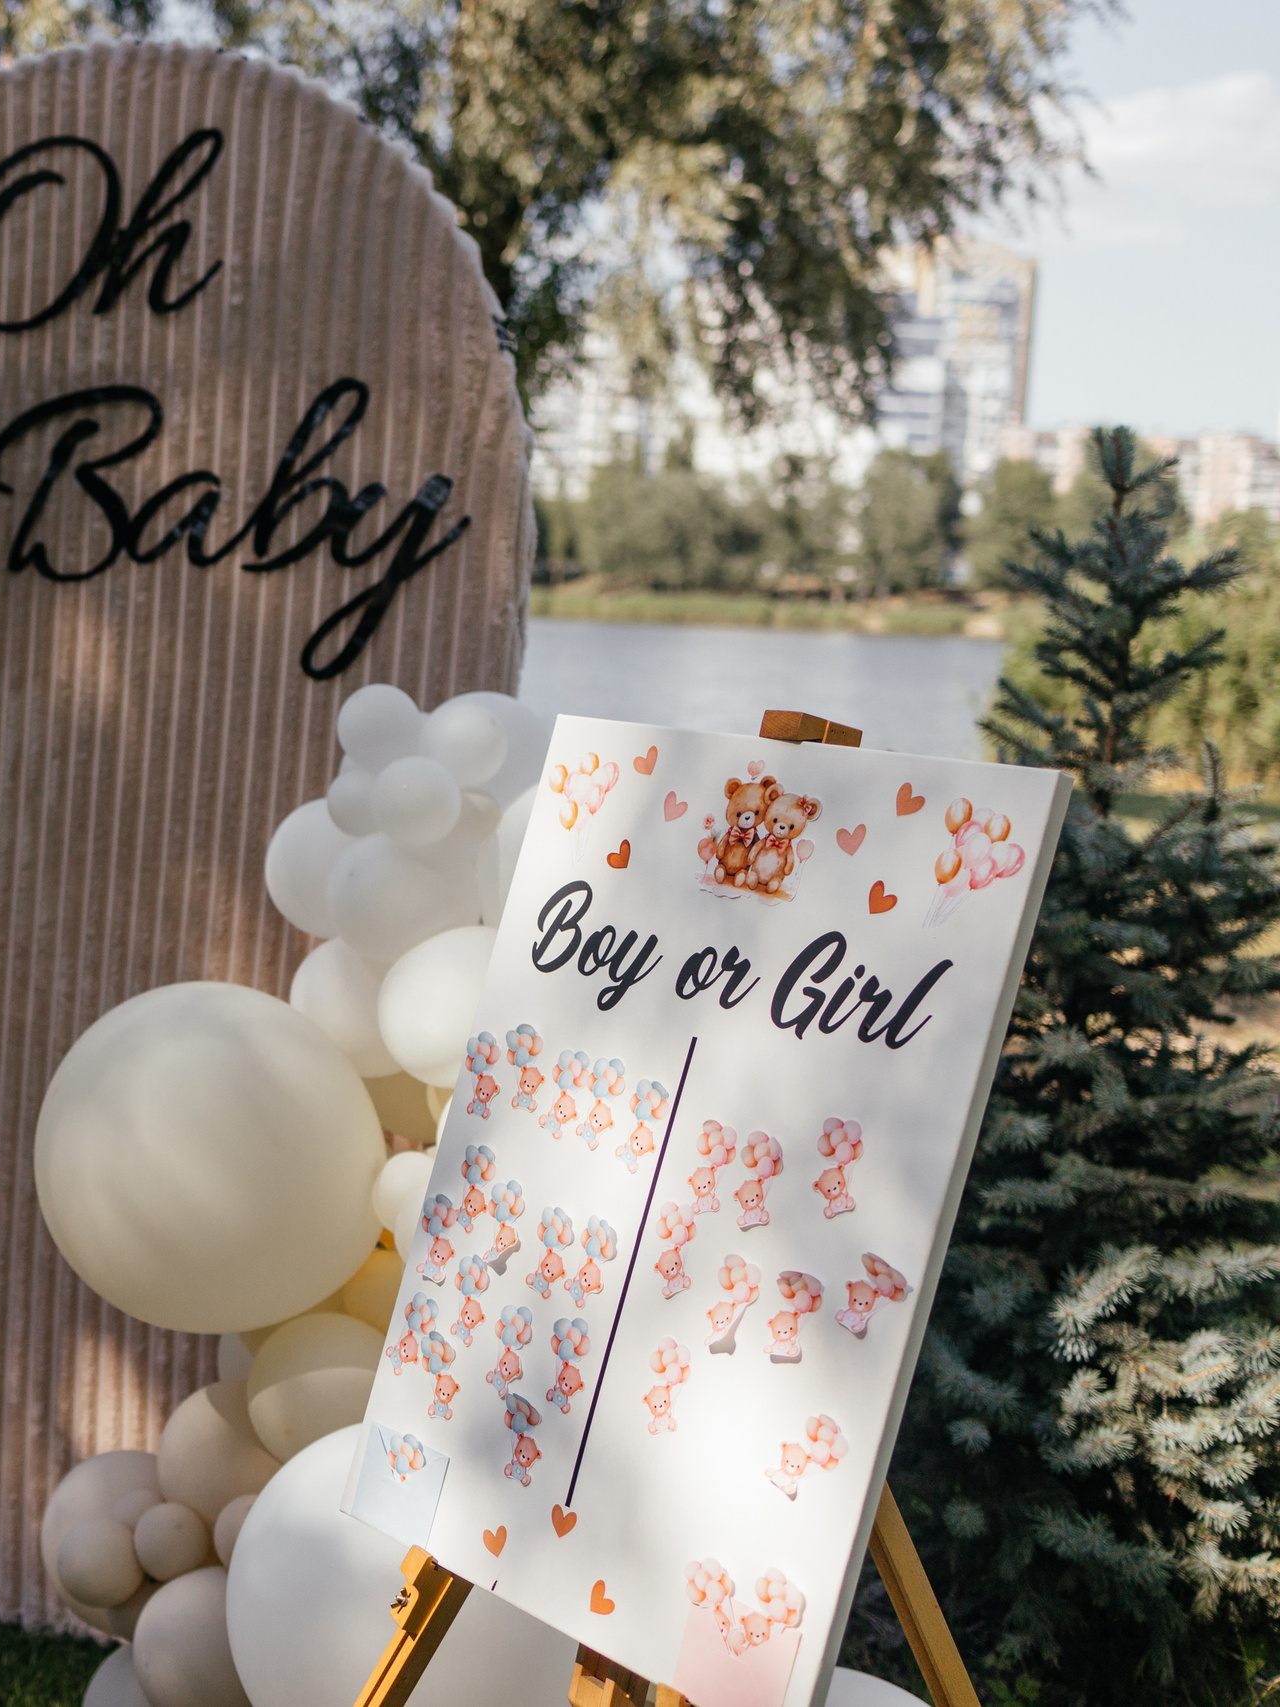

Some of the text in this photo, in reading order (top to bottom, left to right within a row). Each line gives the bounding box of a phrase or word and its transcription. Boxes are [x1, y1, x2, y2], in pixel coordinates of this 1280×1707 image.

[532, 880, 954, 1049] Boy or Girl
